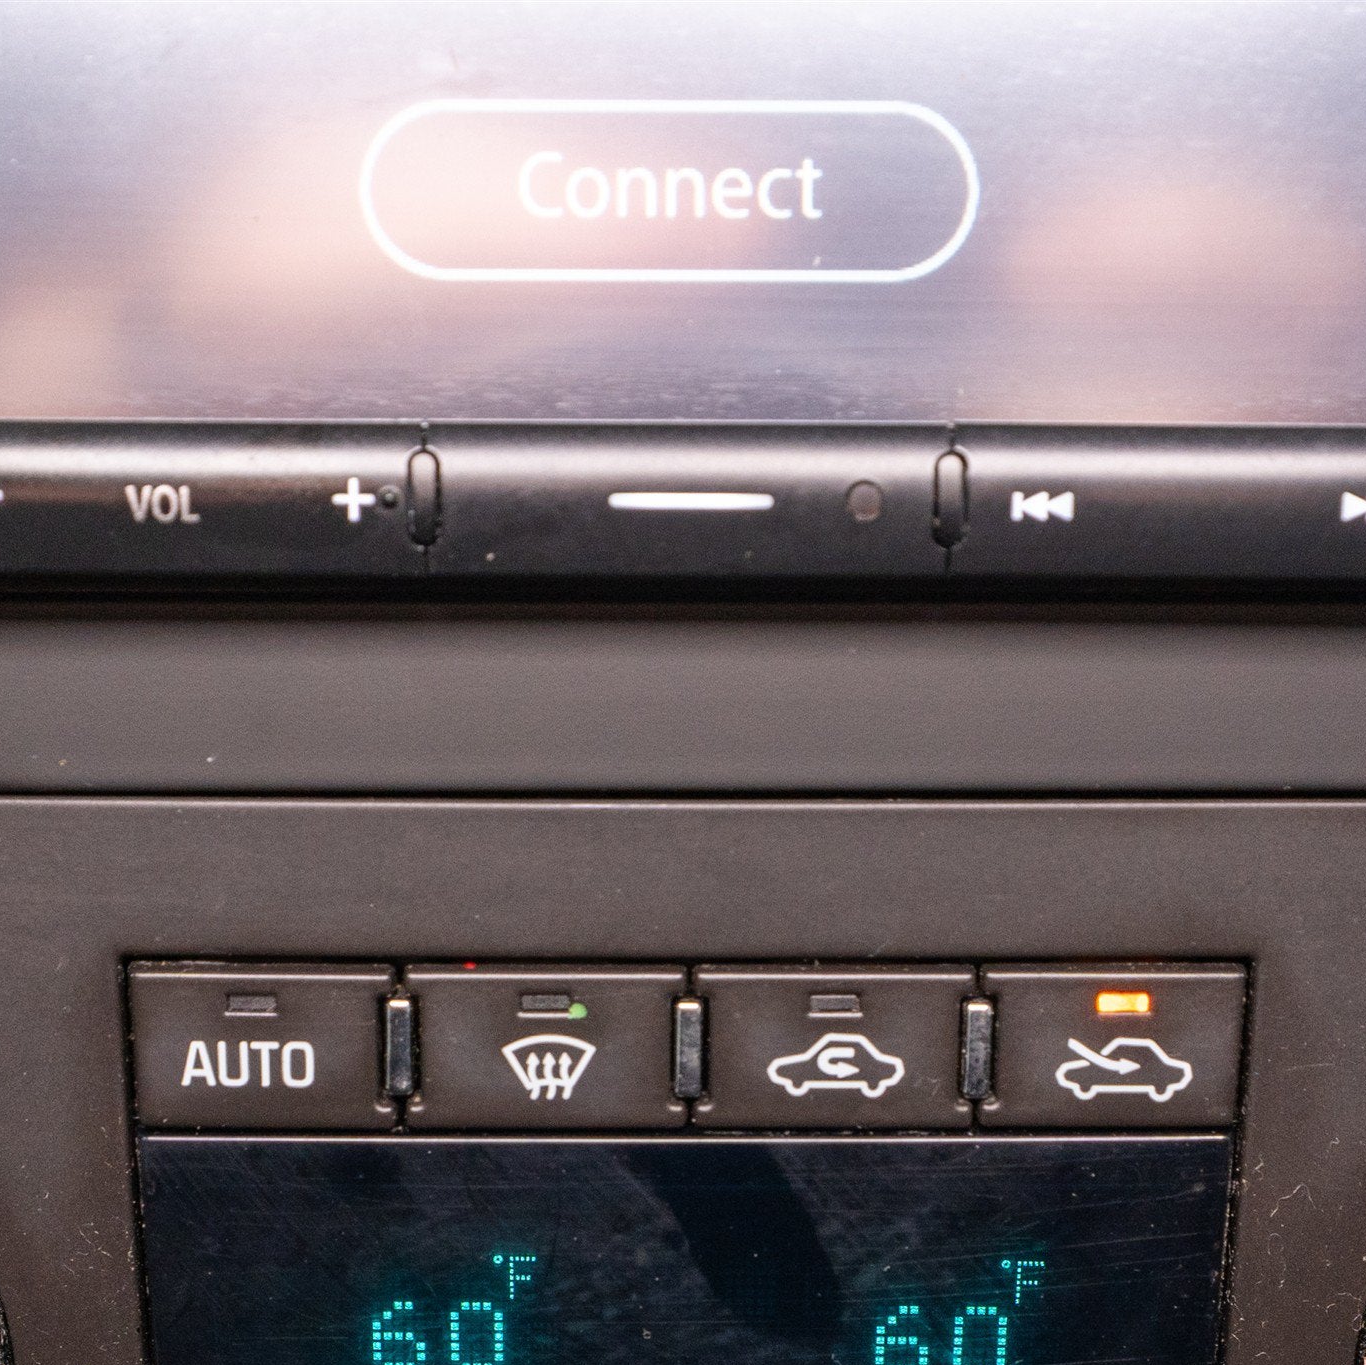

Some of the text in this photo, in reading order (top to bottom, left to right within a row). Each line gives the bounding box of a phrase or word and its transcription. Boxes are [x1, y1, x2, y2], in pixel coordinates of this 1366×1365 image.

[518, 150, 823, 219] Connect
[125, 485, 200, 522] VOL
[181, 1040, 315, 1088] AUTO
